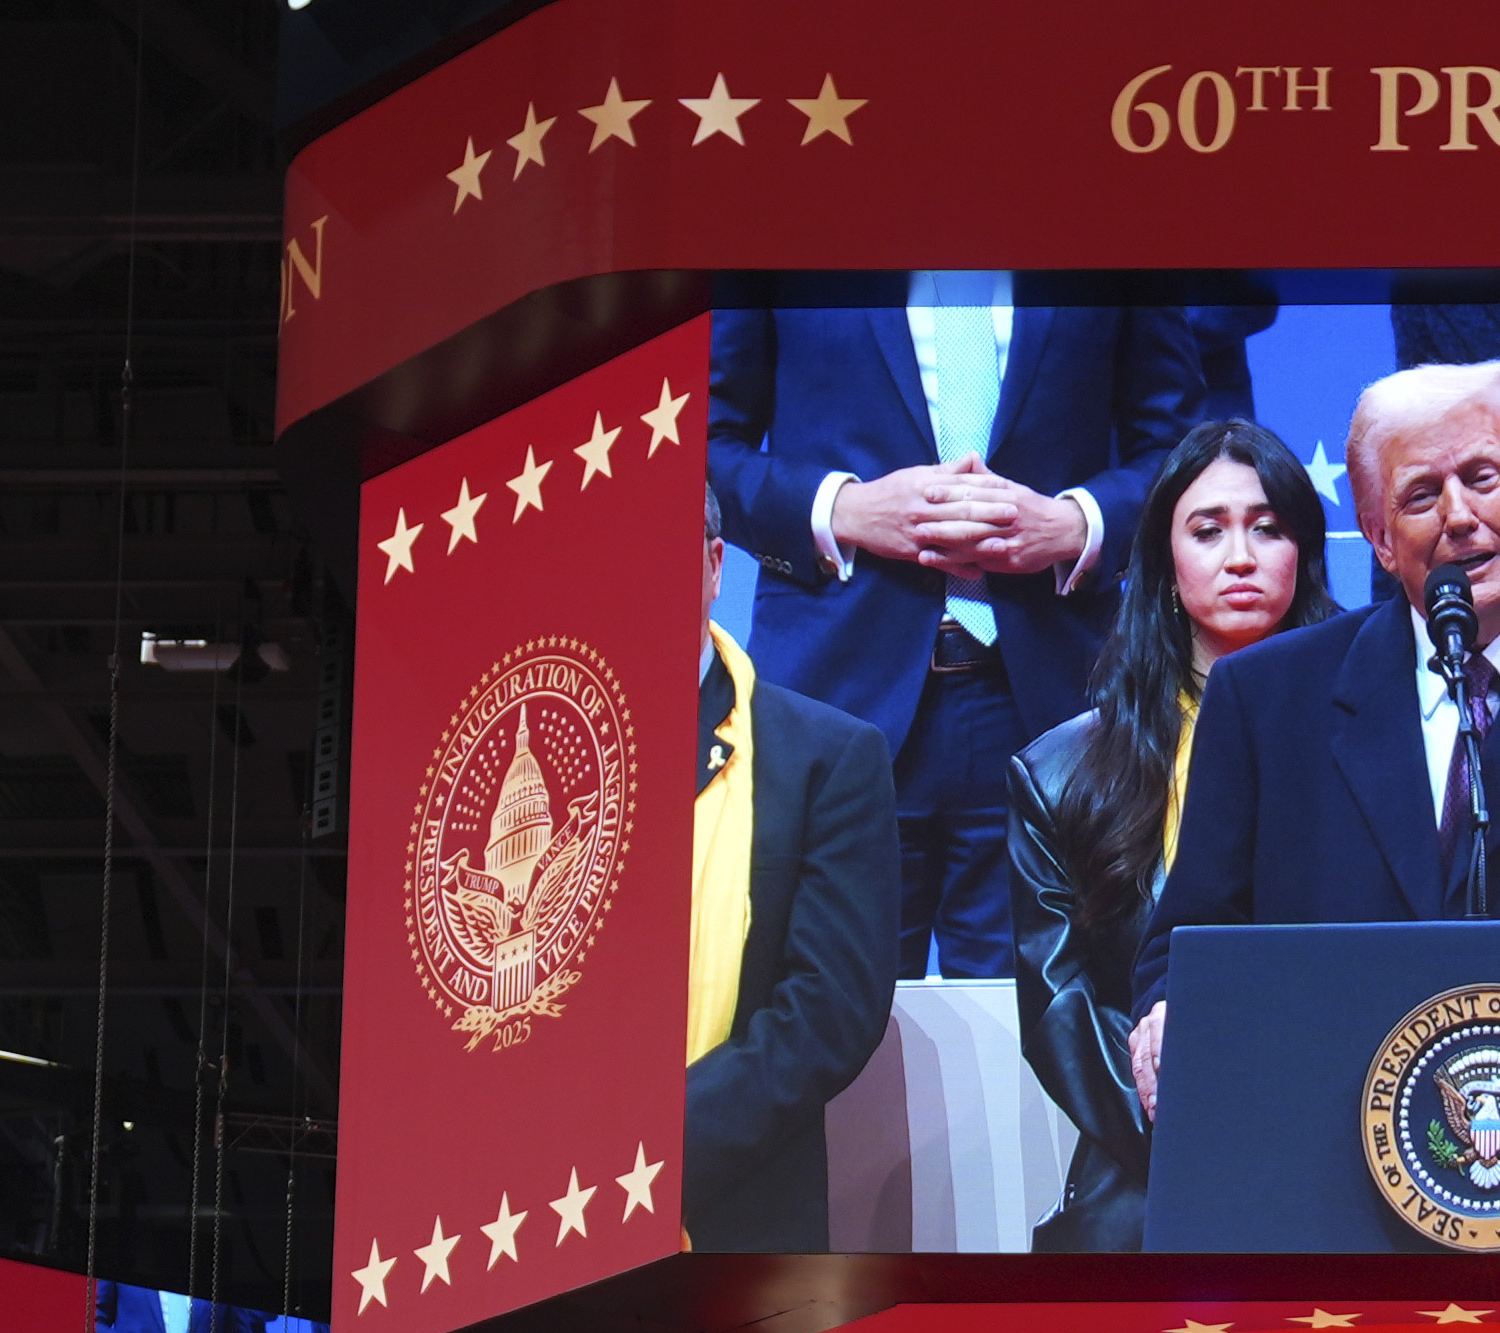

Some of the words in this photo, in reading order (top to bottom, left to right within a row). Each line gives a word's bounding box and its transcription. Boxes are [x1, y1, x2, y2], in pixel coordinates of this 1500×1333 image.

[1111, 64, 1332, 153] 60TH
[441, 662, 580, 785] INAUGURATION
[580, 683, 605, 719] OF
[415, 818, 451, 975] PRESIDENT
[449, 967, 489, 1003] AND
[538, 914, 584, 974] VICE
[581, 740, 621, 918] PRESIDENT
[537, 824, 574, 871] VANCE
[464, 871, 500, 894] TRUMP
[491, 1017, 532, 1053] 2025
[1370, 995, 1481, 1113] PRESIDENT
[1372, 1123, 1391, 1160] THE
[1383, 1164, 1401, 1188] OF
[1401, 1184, 1463, 1241] SEAL
